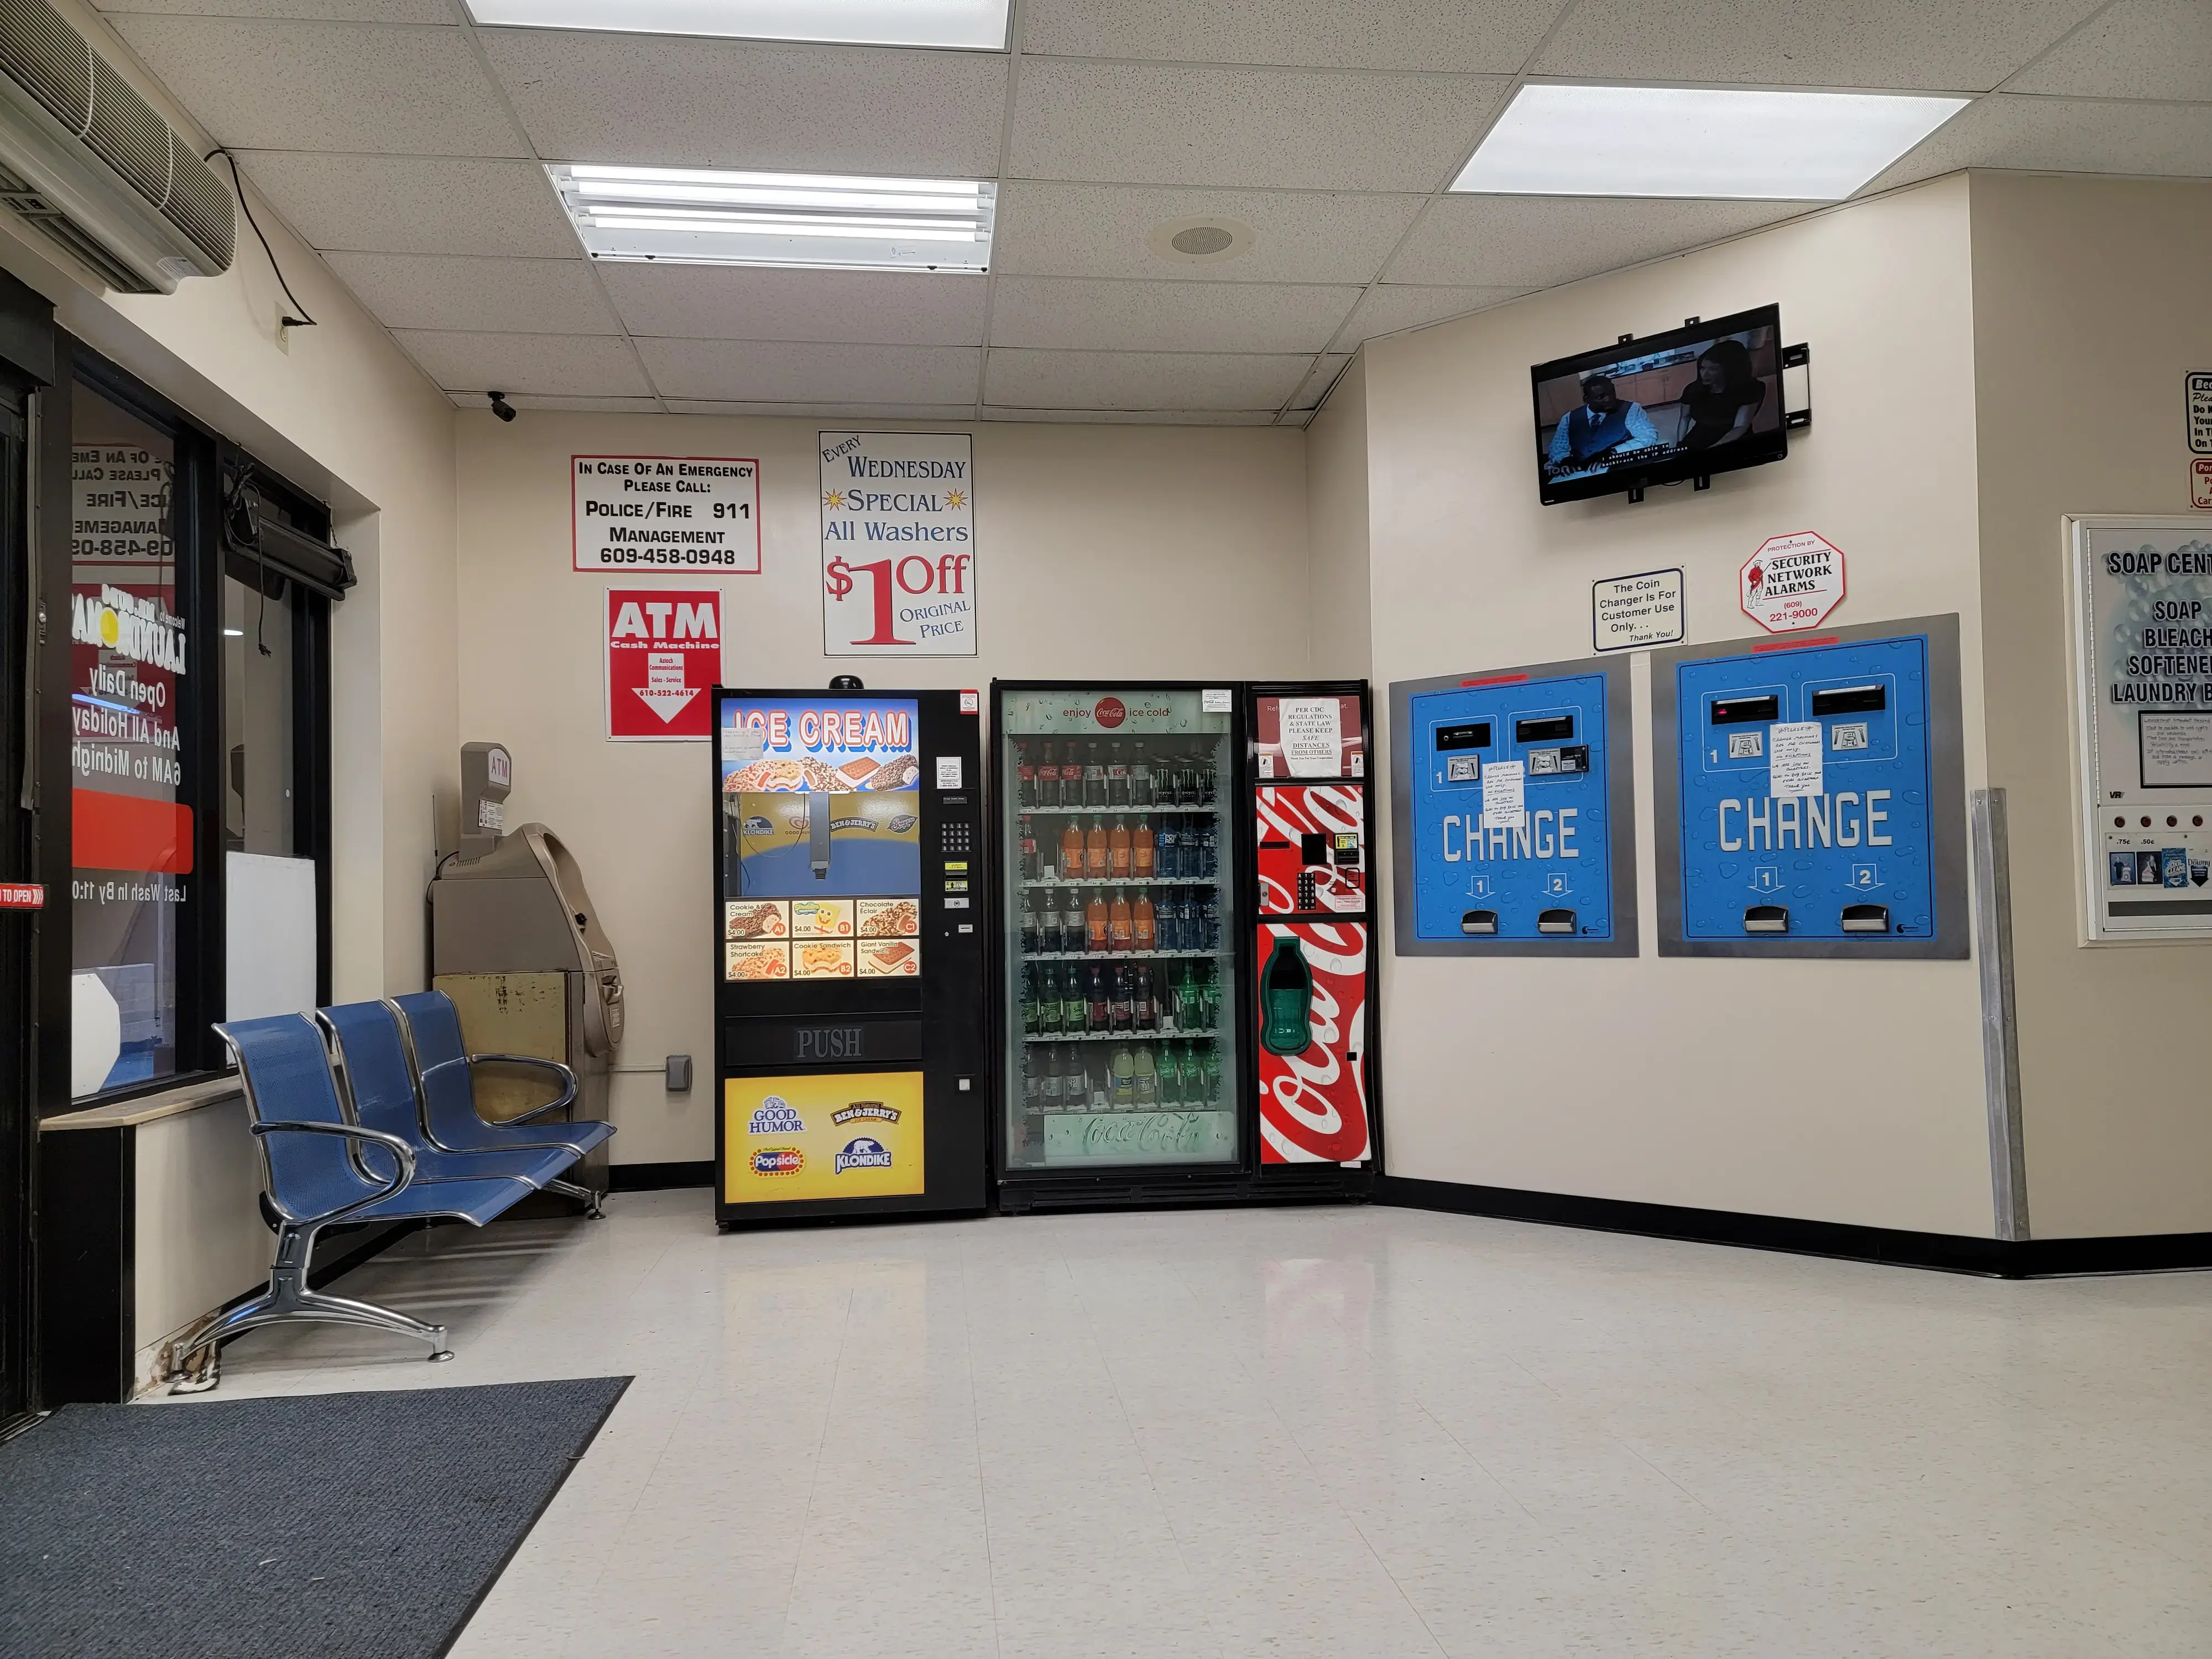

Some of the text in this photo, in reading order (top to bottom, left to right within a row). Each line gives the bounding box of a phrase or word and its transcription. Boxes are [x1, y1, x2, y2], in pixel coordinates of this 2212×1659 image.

[2193, 405, 2205, 414] Do
[2194, 427, 2203, 436] In
[822, 435, 861, 462] EVERY
[2195, 439, 2207, 447] On
[1602, 457, 1634, 467] backtrace
[1662, 446, 1688, 455] address
[579, 462, 753, 477] IN CASE OF AN EMERGENCY
[847, 456, 966, 478] WEDNESDAY
[624, 479, 711, 493] PLEASE CALL:
[847, 489, 943, 512] SPECIAL
[586, 500, 749, 519] POLICE/FIRE 911
[609, 527, 725, 544] MANAGEMENT
[825, 521, 968, 541] All Washers
[1767, 542, 1806, 552] PROTECTION
[600, 548, 735, 565] 609-458-0948
[1772, 551, 1831, 570] SECURITY
[2109, 552, 2162, 574] SOAP
[896, 554, 971, 594] Off
[1768, 565, 1832, 583] NETWORK
[1614, 580, 1660, 593] The Coin
[1765, 580, 1815, 597] ALARMS
[1600, 591, 1676, 608] Changer Is For
[1784, 601, 1802, 609] (609)
[900, 600, 971, 622] ORIGINAL
[1602, 604, 1674, 621] Customer Use
[1770, 608, 1818, 622] 221-9000
[2154, 601, 2202, 620] SOAP
[611, 602, 718, 638] ATM
[919, 620, 964, 638] PRICE
[1630, 630, 1673, 641] Thank You!
[2145, 628, 2212, 647] BLEACH
[2129, 655, 2212, 675] SOFTENE
[2113, 683, 2197, 702] LAUNDRY
[1063, 708, 1091, 718] enjoy
[799, 709, 910, 749] CREAM
[1710, 749, 1718, 763] 1
[491, 756, 508, 779] ATM
[1436, 771, 1442, 784] 1
[1719, 789, 1892, 852] CHANGE
[1443, 808, 1579, 863] CHANGE
[2188, 858, 2210, 867] Downy
[1477, 878, 1563, 893] 1 2
[1762, 870, 1871, 886] 1 2
[3, 889, 31, 903] TO OPEN
[797, 1028, 862, 1058] PUSH
[754, 1109, 796, 1121] GOOD
[749, 1121, 803, 1134] HUMOR
[755, 1154, 799, 1168] Popsicle
[836, 1153, 890, 1173] KLONDIKE
